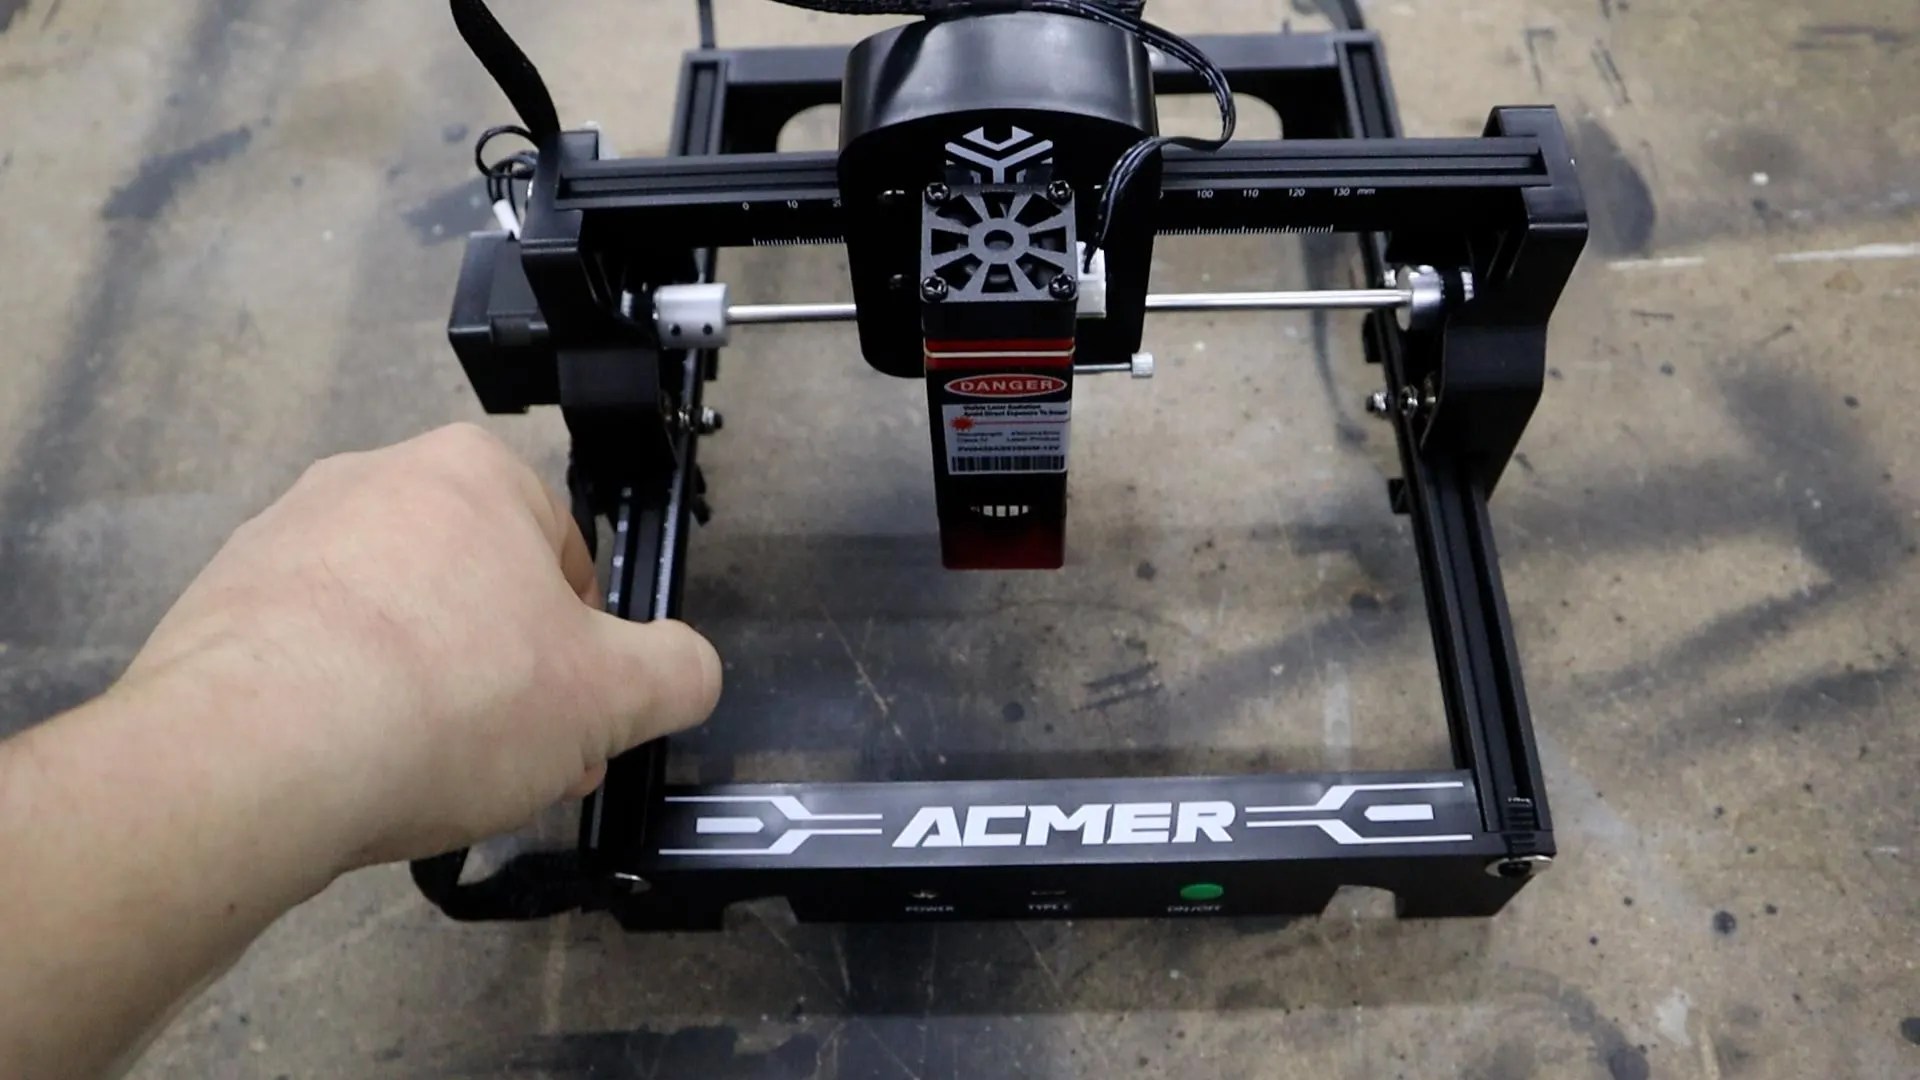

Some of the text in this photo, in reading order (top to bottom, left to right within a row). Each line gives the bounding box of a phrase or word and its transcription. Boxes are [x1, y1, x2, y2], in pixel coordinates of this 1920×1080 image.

[1196, 187, 1376, 198] 100 110 120 130 mm
[742, 201, 750, 211] 0
[786, 199, 799, 209] 10
[960, 380, 1053, 391] DANGER
[892, 801, 1236, 848] ACMER
